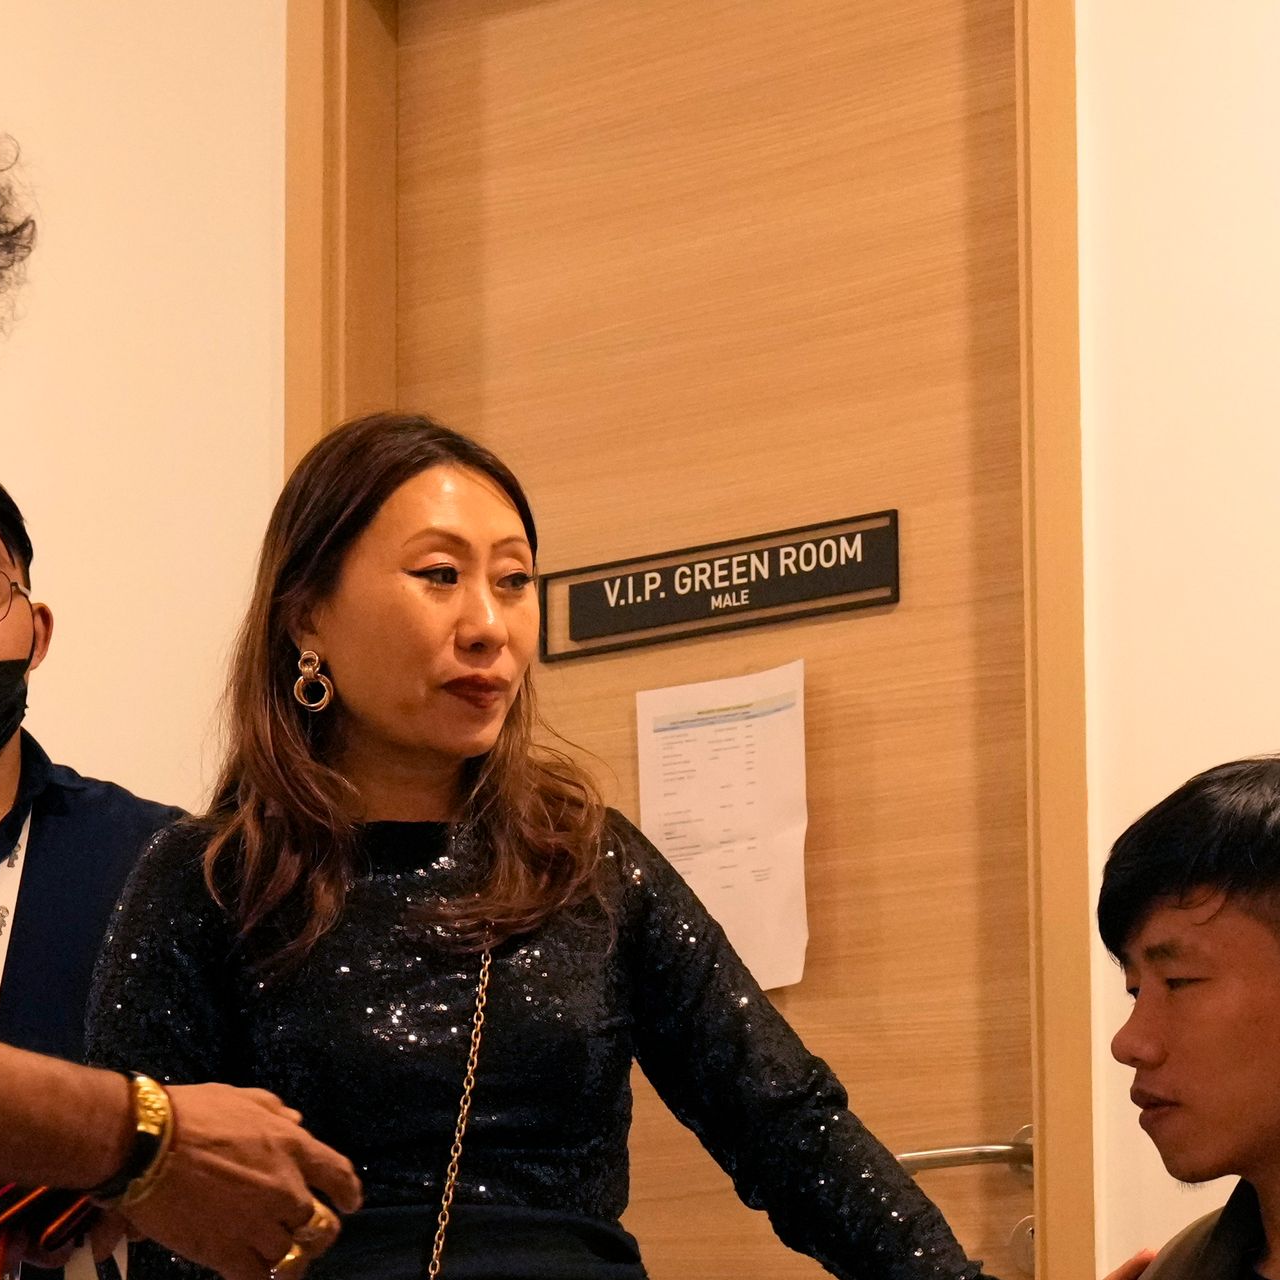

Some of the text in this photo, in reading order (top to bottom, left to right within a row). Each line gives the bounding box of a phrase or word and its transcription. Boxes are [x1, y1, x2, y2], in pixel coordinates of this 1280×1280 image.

[604, 533, 863, 608] V.I.P. GREEN ROOM
[711, 589, 750, 610] MALE
